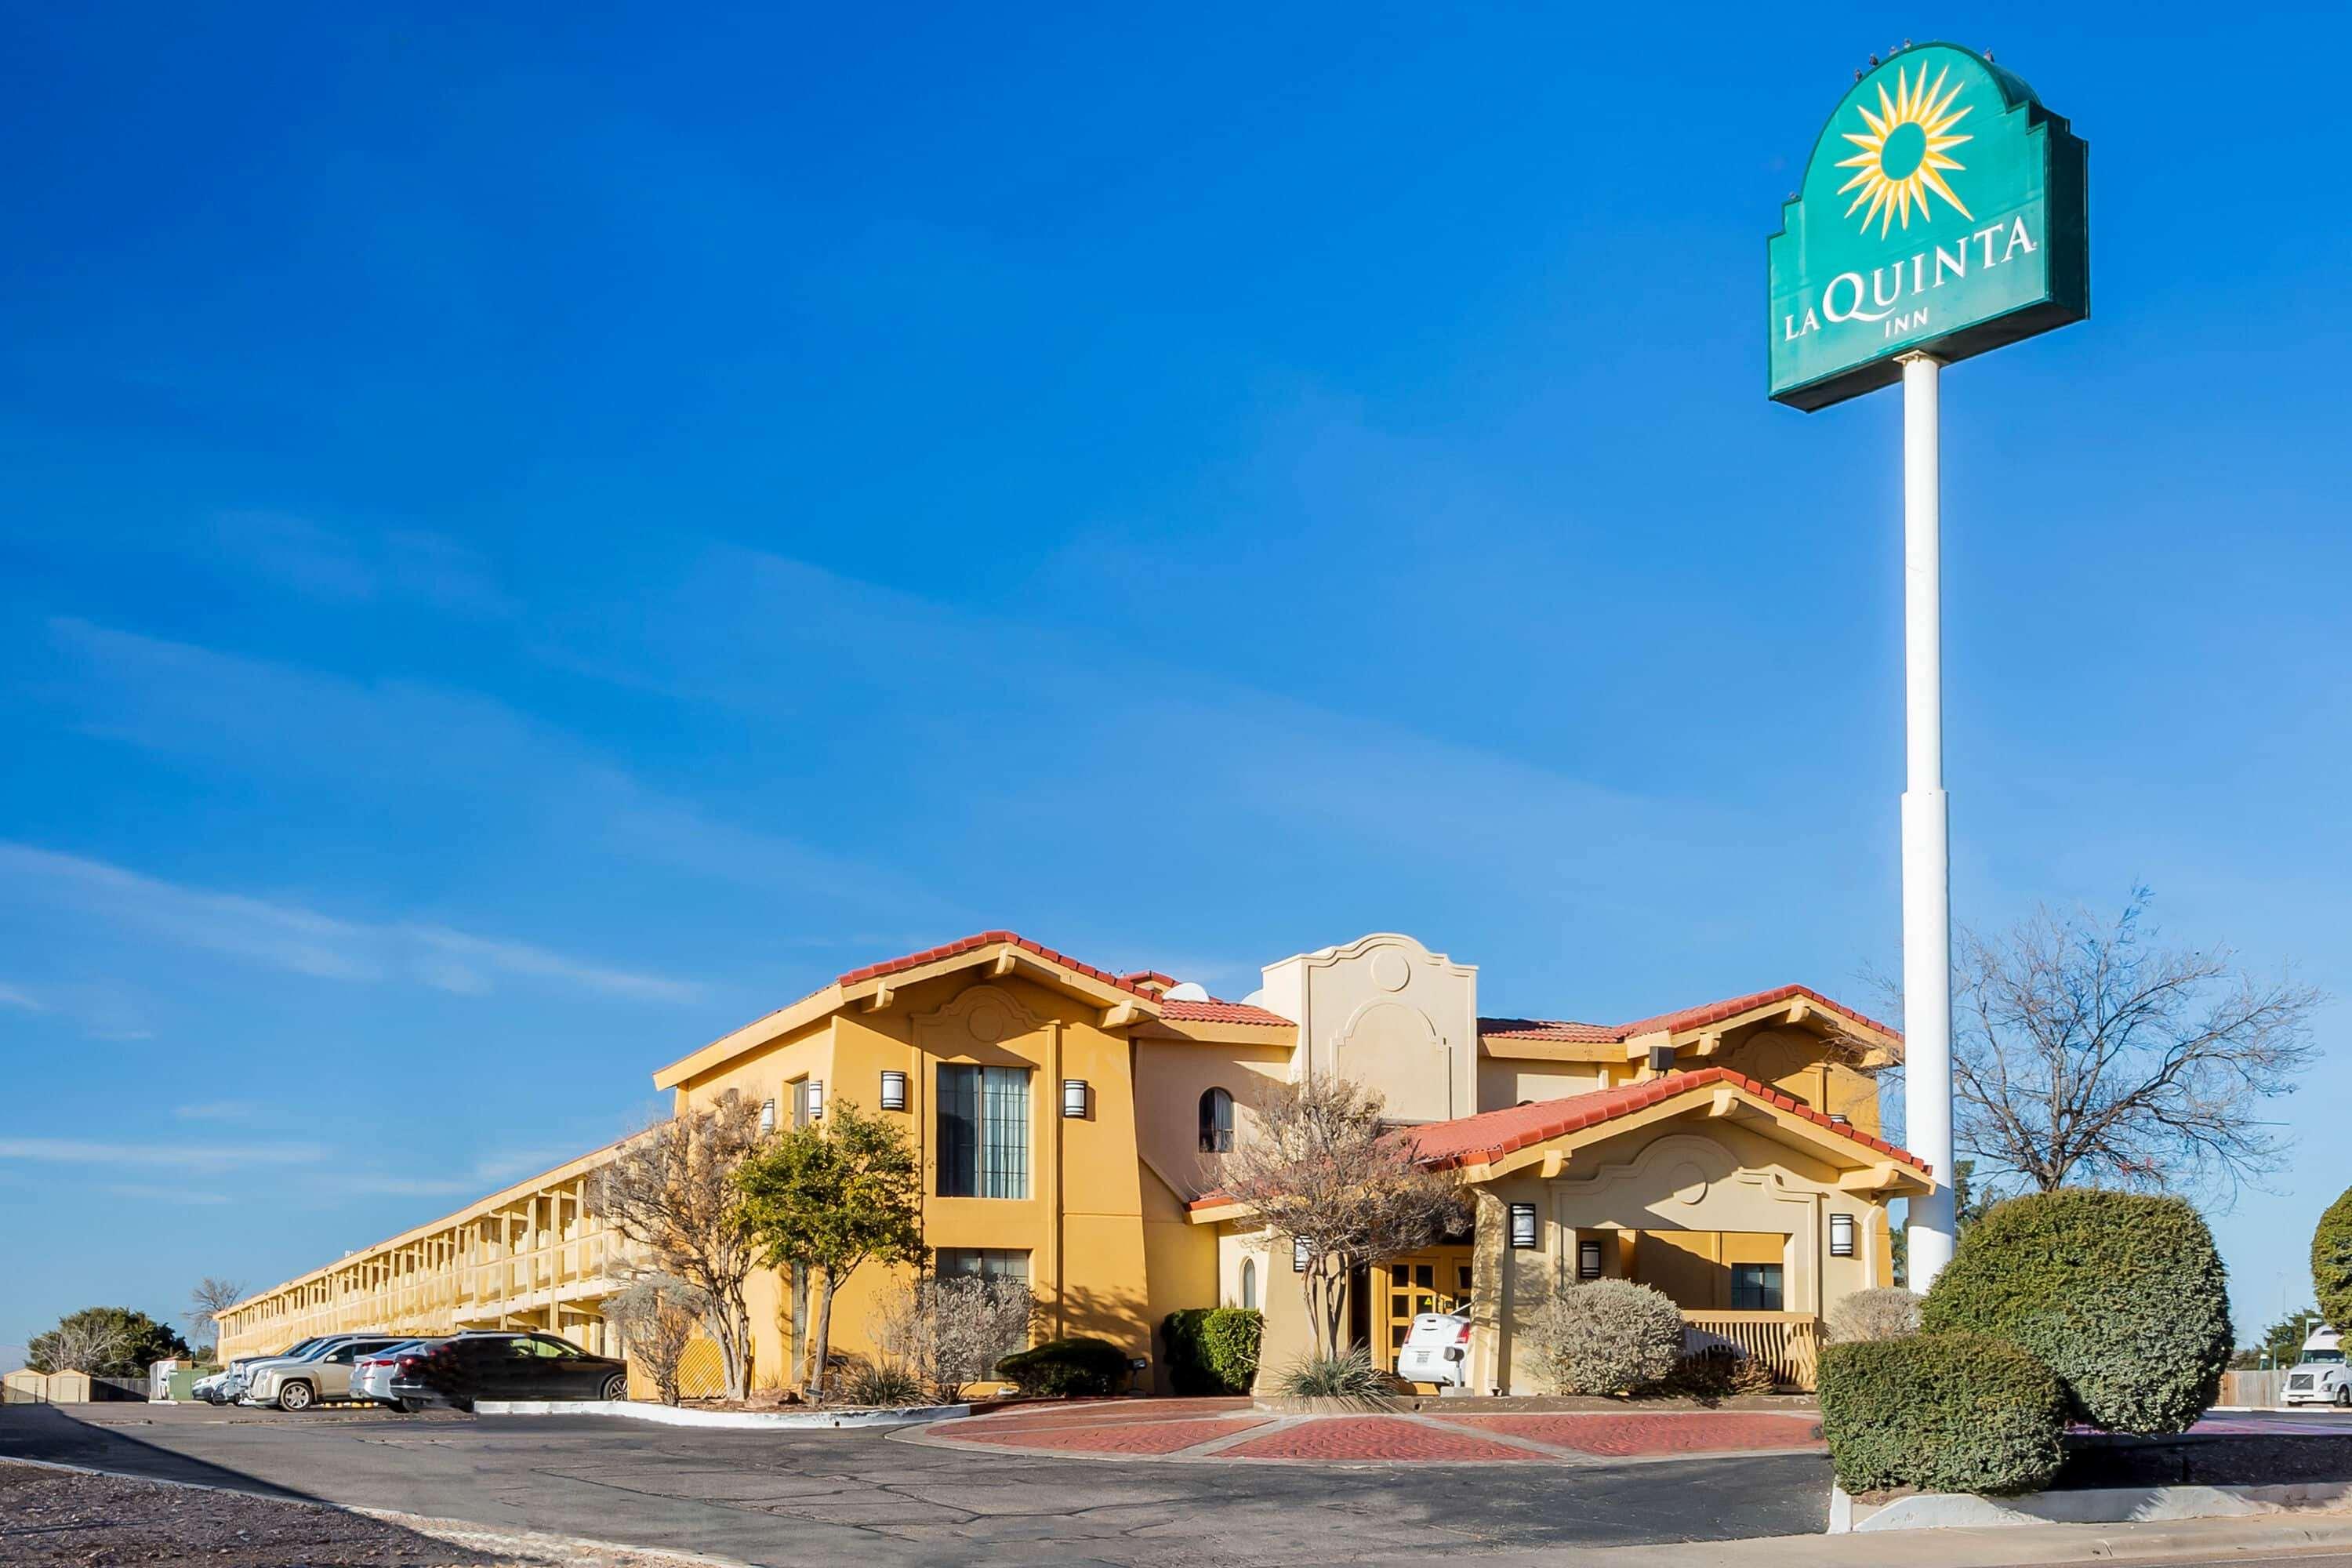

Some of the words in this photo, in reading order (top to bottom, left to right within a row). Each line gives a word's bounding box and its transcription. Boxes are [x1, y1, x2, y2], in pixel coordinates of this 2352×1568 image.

[1784, 307, 1821, 342] LA
[1822, 215, 2038, 323] QUINTA
[1885, 307, 1928, 338] INN
